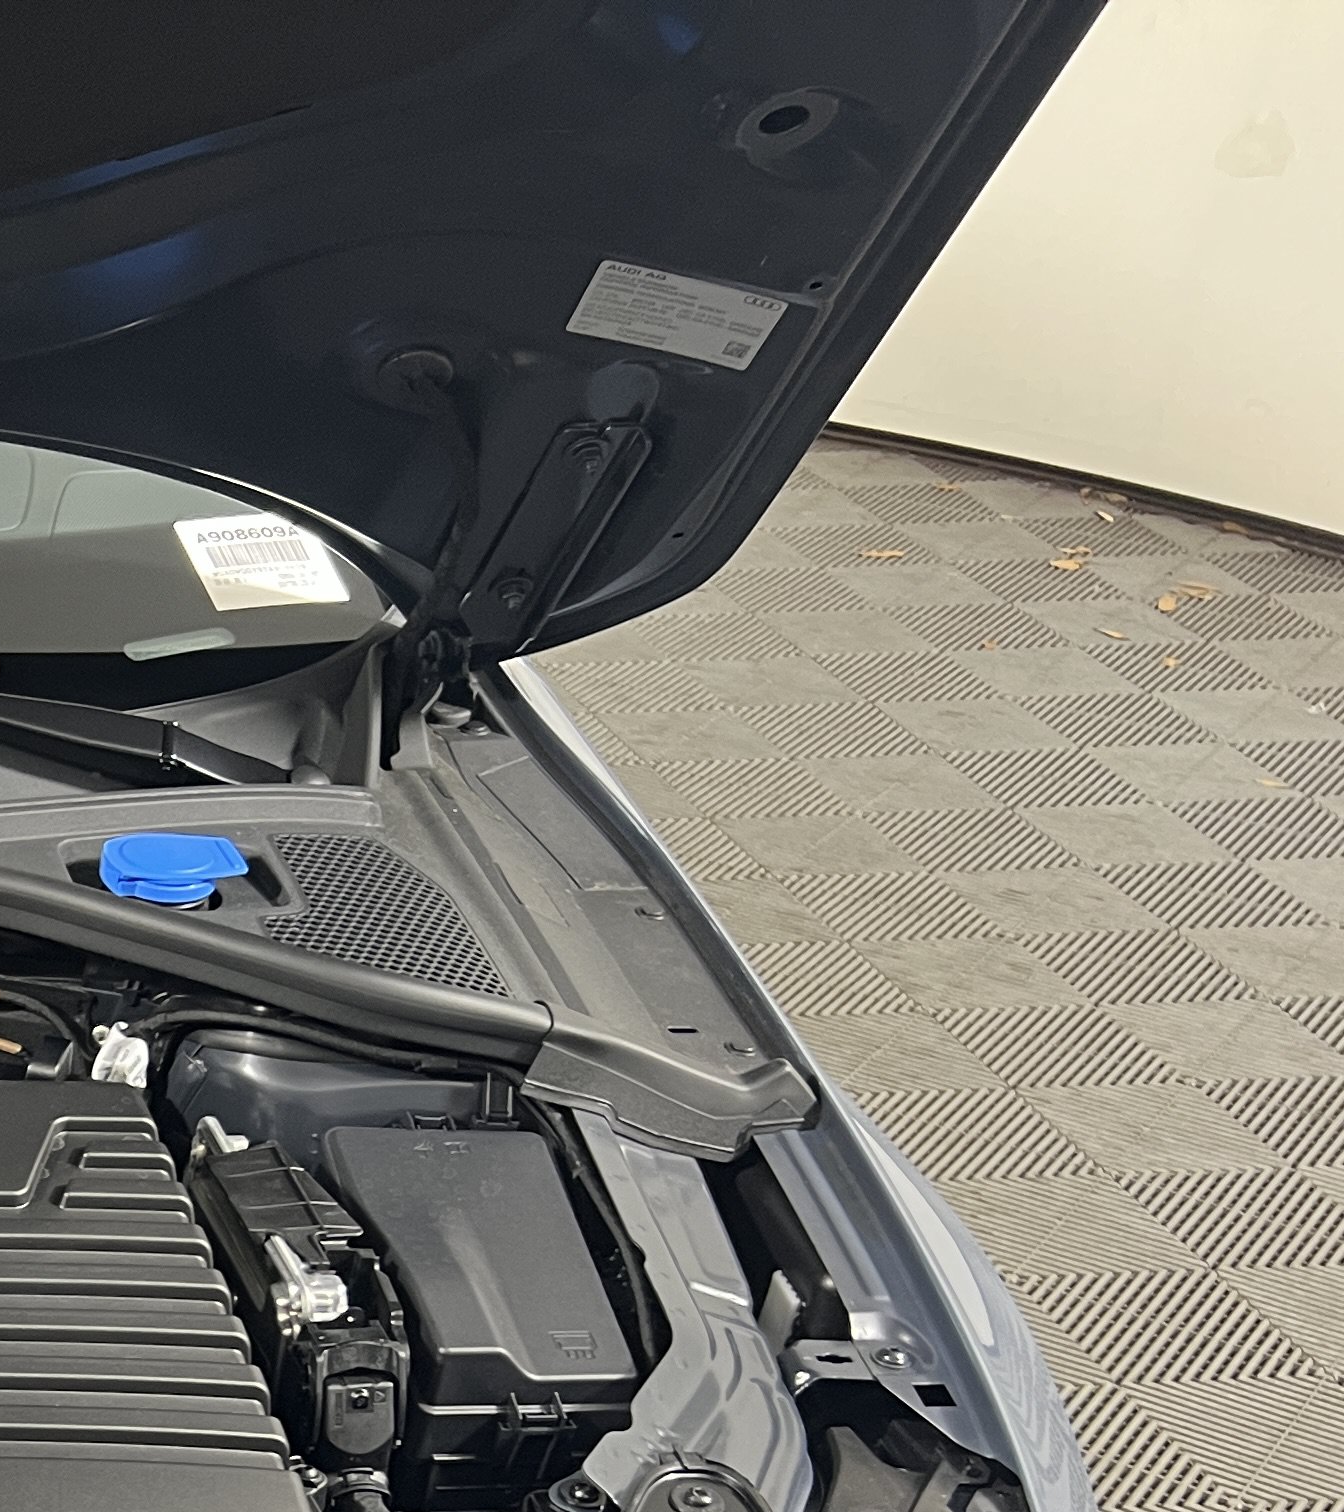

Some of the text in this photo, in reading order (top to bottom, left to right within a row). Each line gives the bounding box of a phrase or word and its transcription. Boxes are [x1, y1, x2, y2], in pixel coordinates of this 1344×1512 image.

[607, 263, 666, 281] AUDI AG
[197, 526, 300, 544] A908609A
